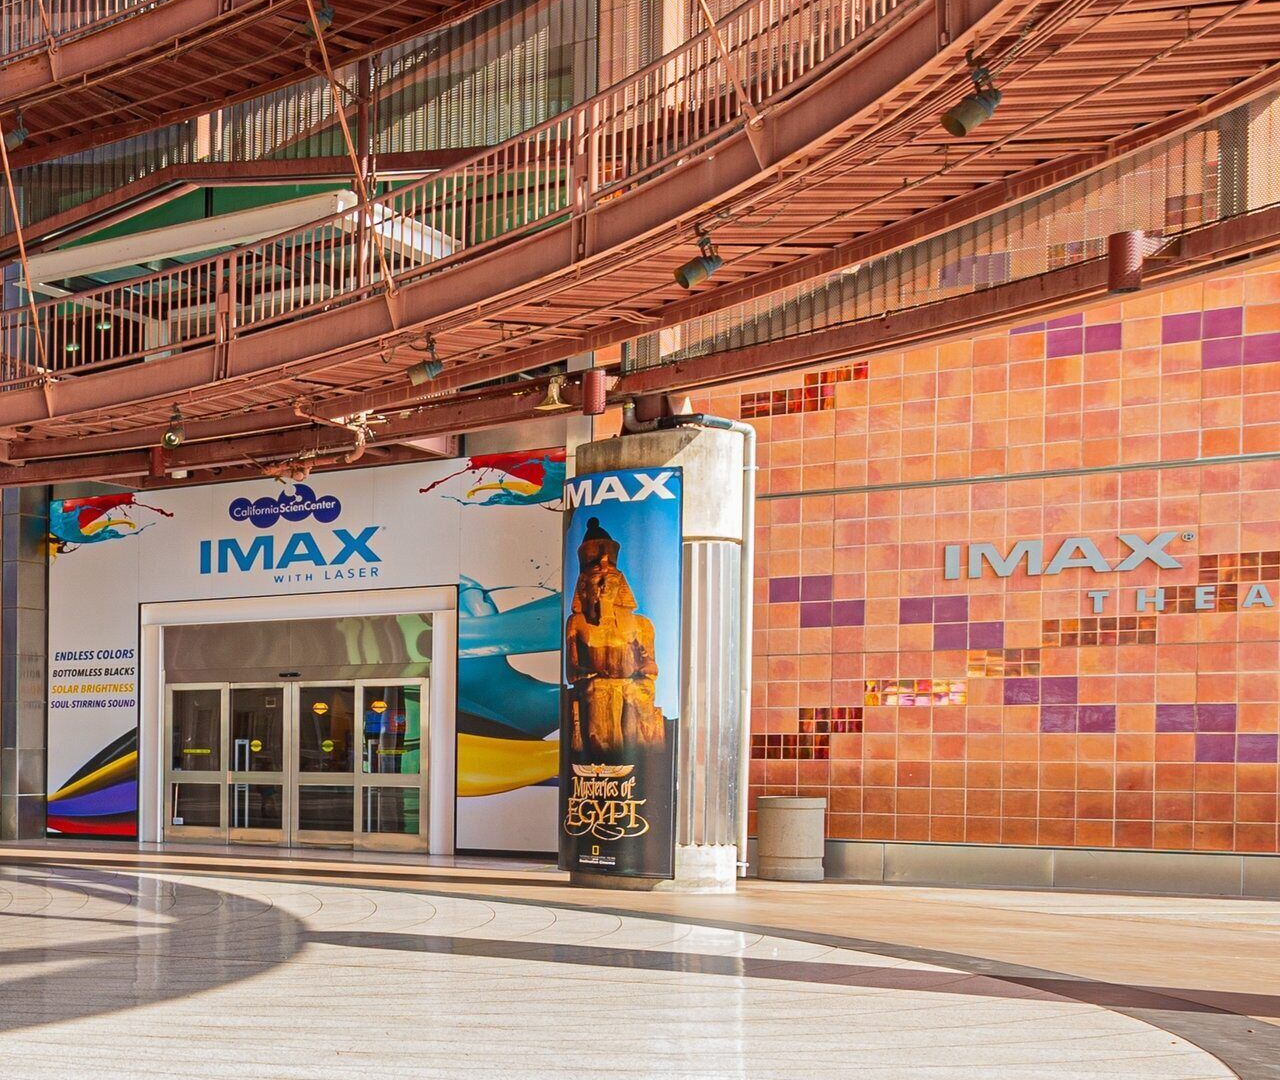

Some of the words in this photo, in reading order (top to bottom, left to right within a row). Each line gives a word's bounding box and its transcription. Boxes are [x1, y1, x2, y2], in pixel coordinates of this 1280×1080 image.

[199, 525, 383, 575] IMAX
[273, 574, 314, 584] WITH
[324, 566, 379, 580] LASER
[54, 650, 95, 662] ENDLESS
[96, 648, 135, 660] COLORS
[52, 667, 103, 678] BOTTOMLESS
[103, 666, 136, 677] BLACKS
[51, 684, 79, 694] SOLAR
[80, 683, 135, 694] BRIGHTNESS
[50, 699, 107, 709] SOUL-STIRRING
[107, 699, 136, 708] SOUND
[571, 776, 619, 799] Mysteries
[620, 776, 636, 799] of
[565, 798, 648, 833] EGYPT
